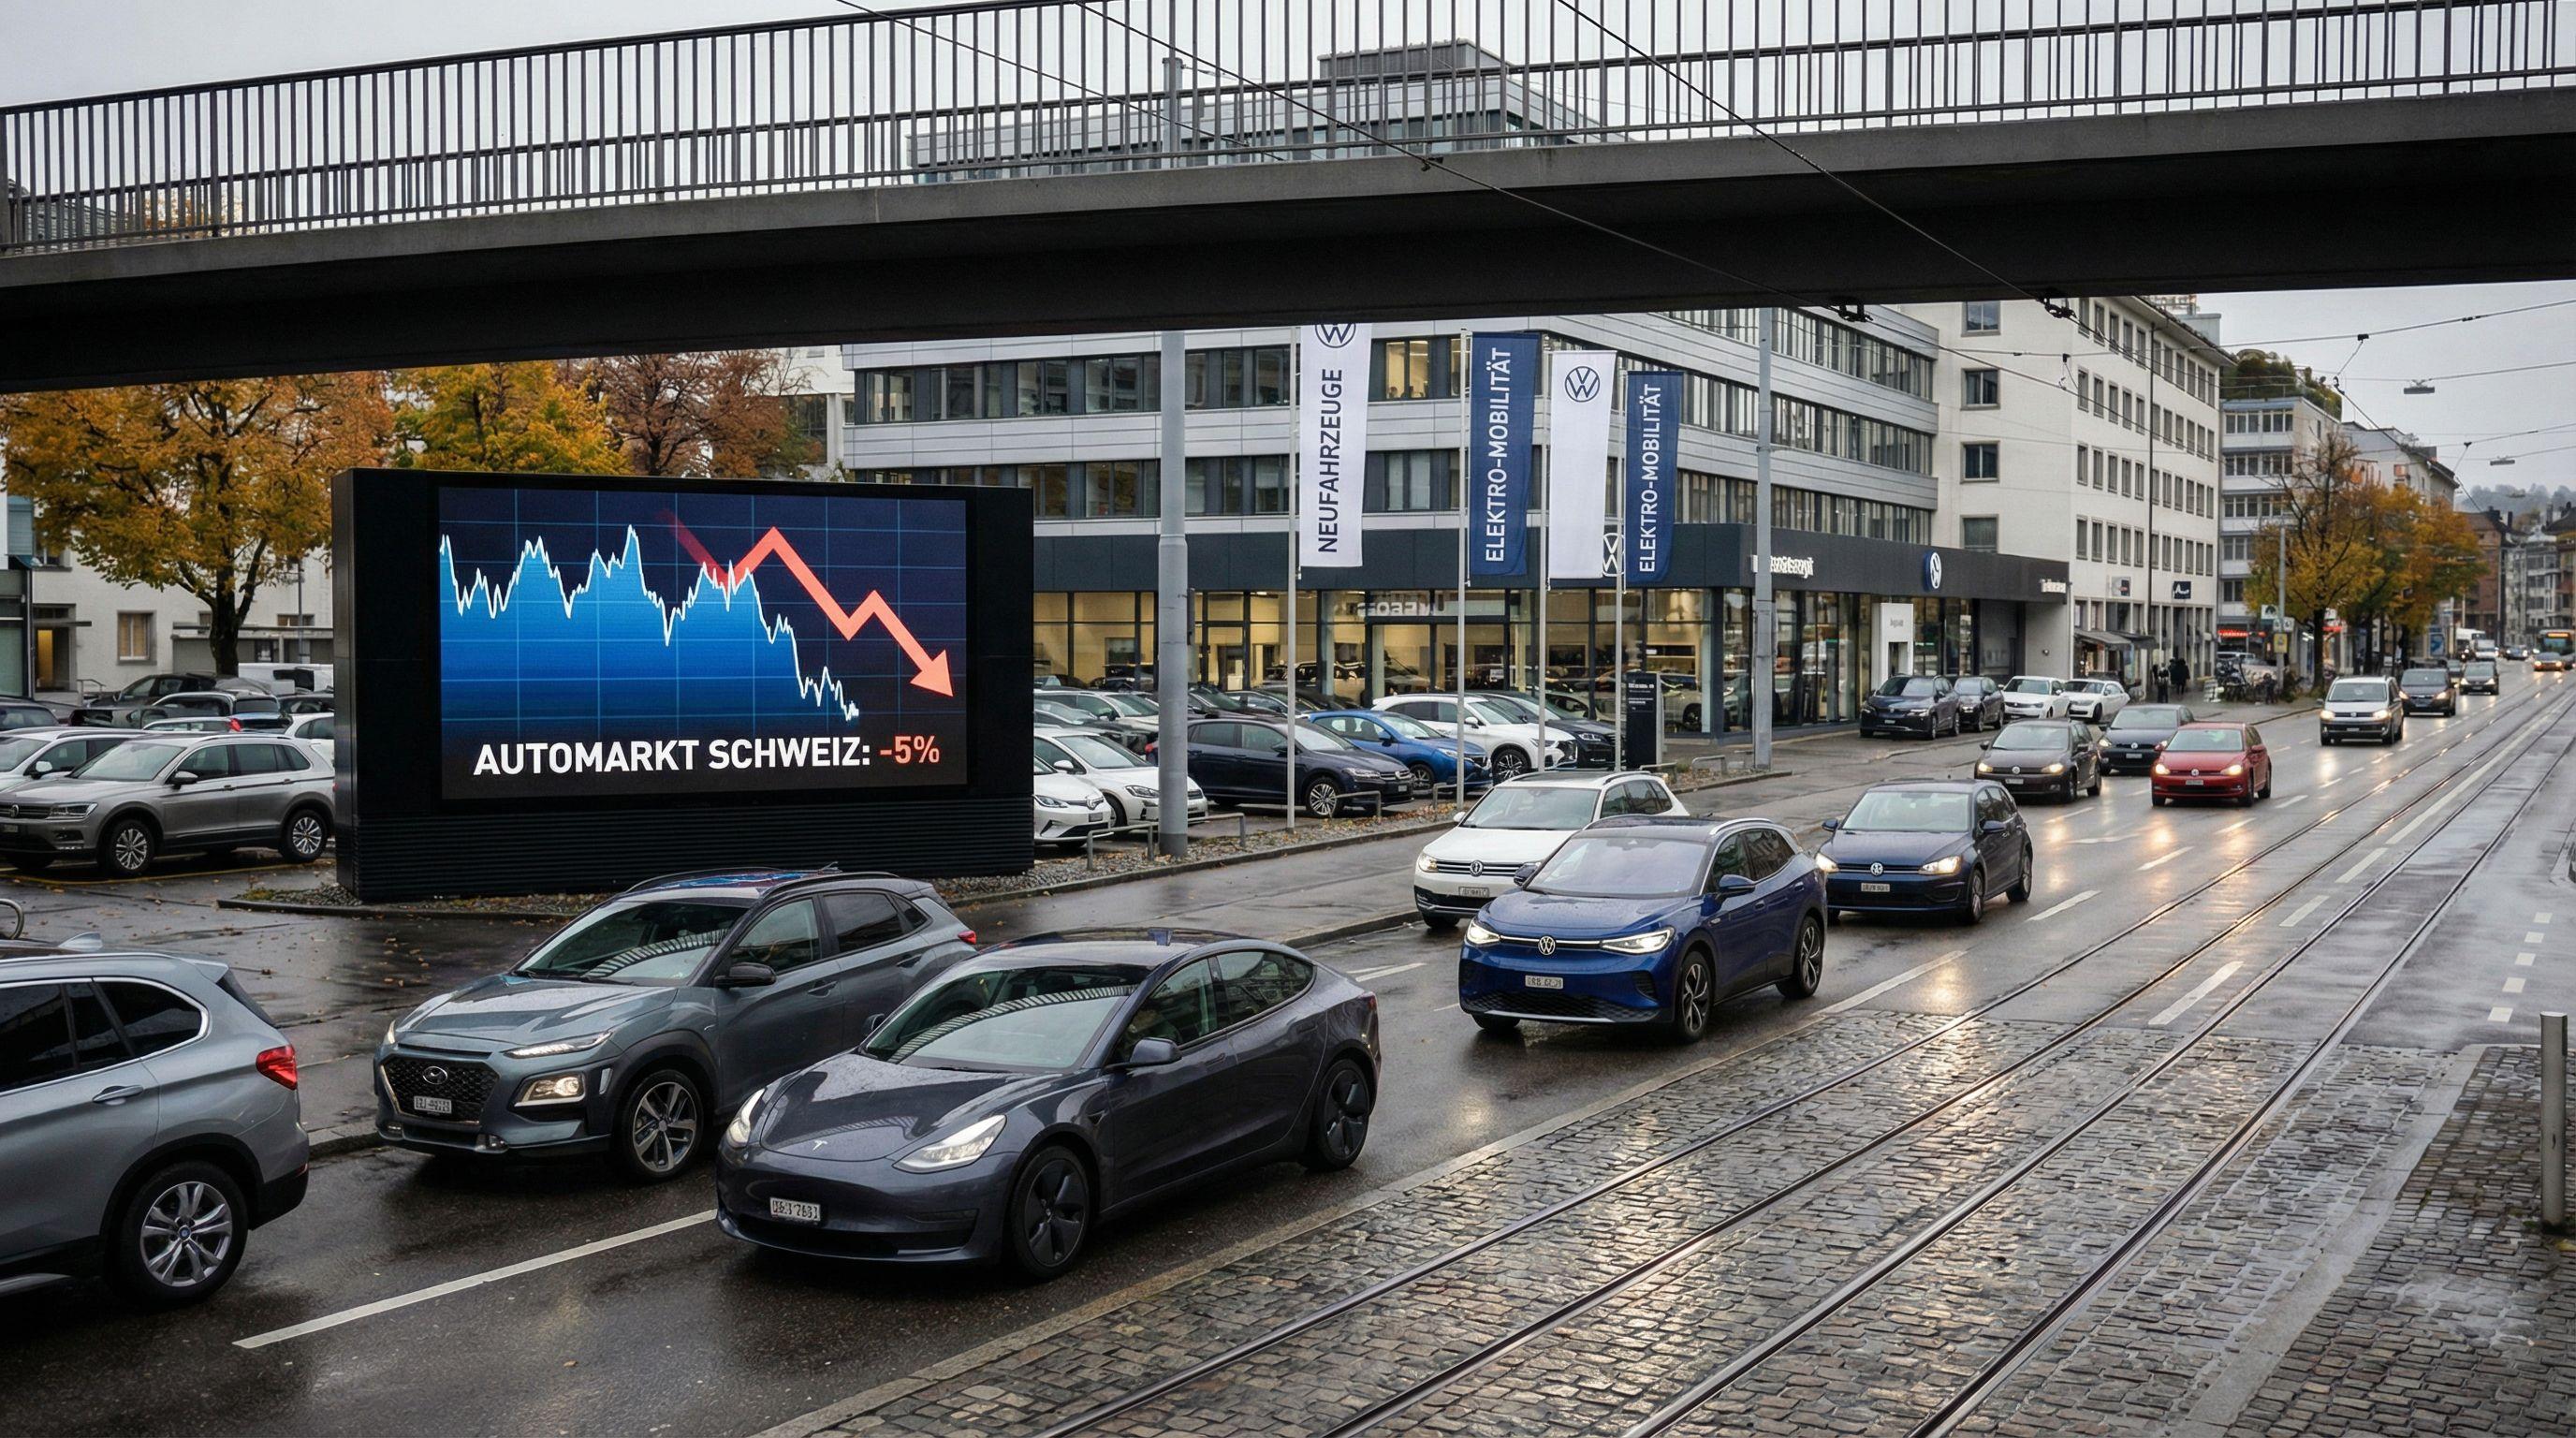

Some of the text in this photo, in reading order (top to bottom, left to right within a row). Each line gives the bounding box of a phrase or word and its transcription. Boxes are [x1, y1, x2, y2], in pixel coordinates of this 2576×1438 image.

[1314, 324, 1356, 348] W
[1318, 369, 1343, 554] NEUFAHRZEUGE
[1486, 347, 1512, 563] ELEKTRO-MOBILITÄT
[1638, 383, 1662, 573] ELEKTRO-MOBILITÄT
[473, 735, 940, 776] AUTOMARKT SCHWEIZ: -5%
